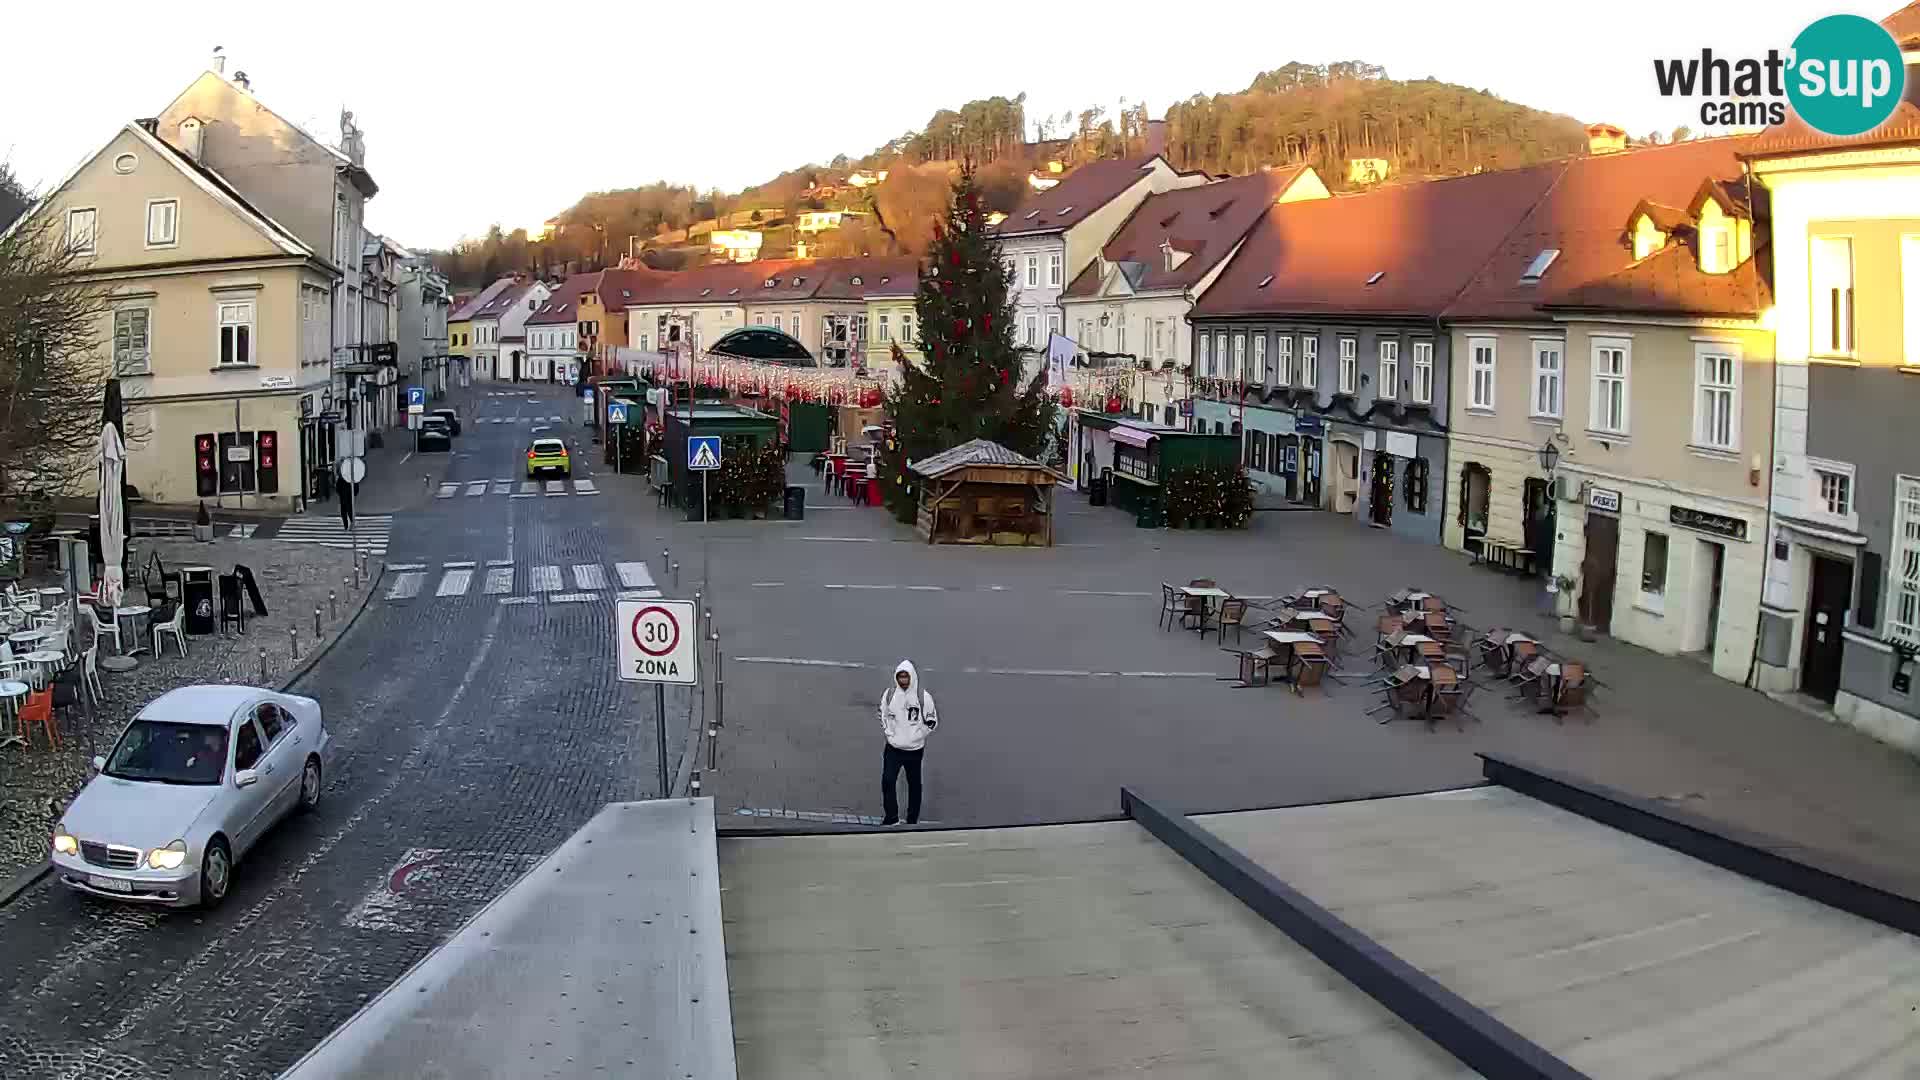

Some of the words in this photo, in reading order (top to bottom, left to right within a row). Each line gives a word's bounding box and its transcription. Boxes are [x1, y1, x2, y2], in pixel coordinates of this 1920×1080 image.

[412, 391, 420, 402] P
[644, 622, 669, 643] 30
[634, 659, 679, 677] ZONA
